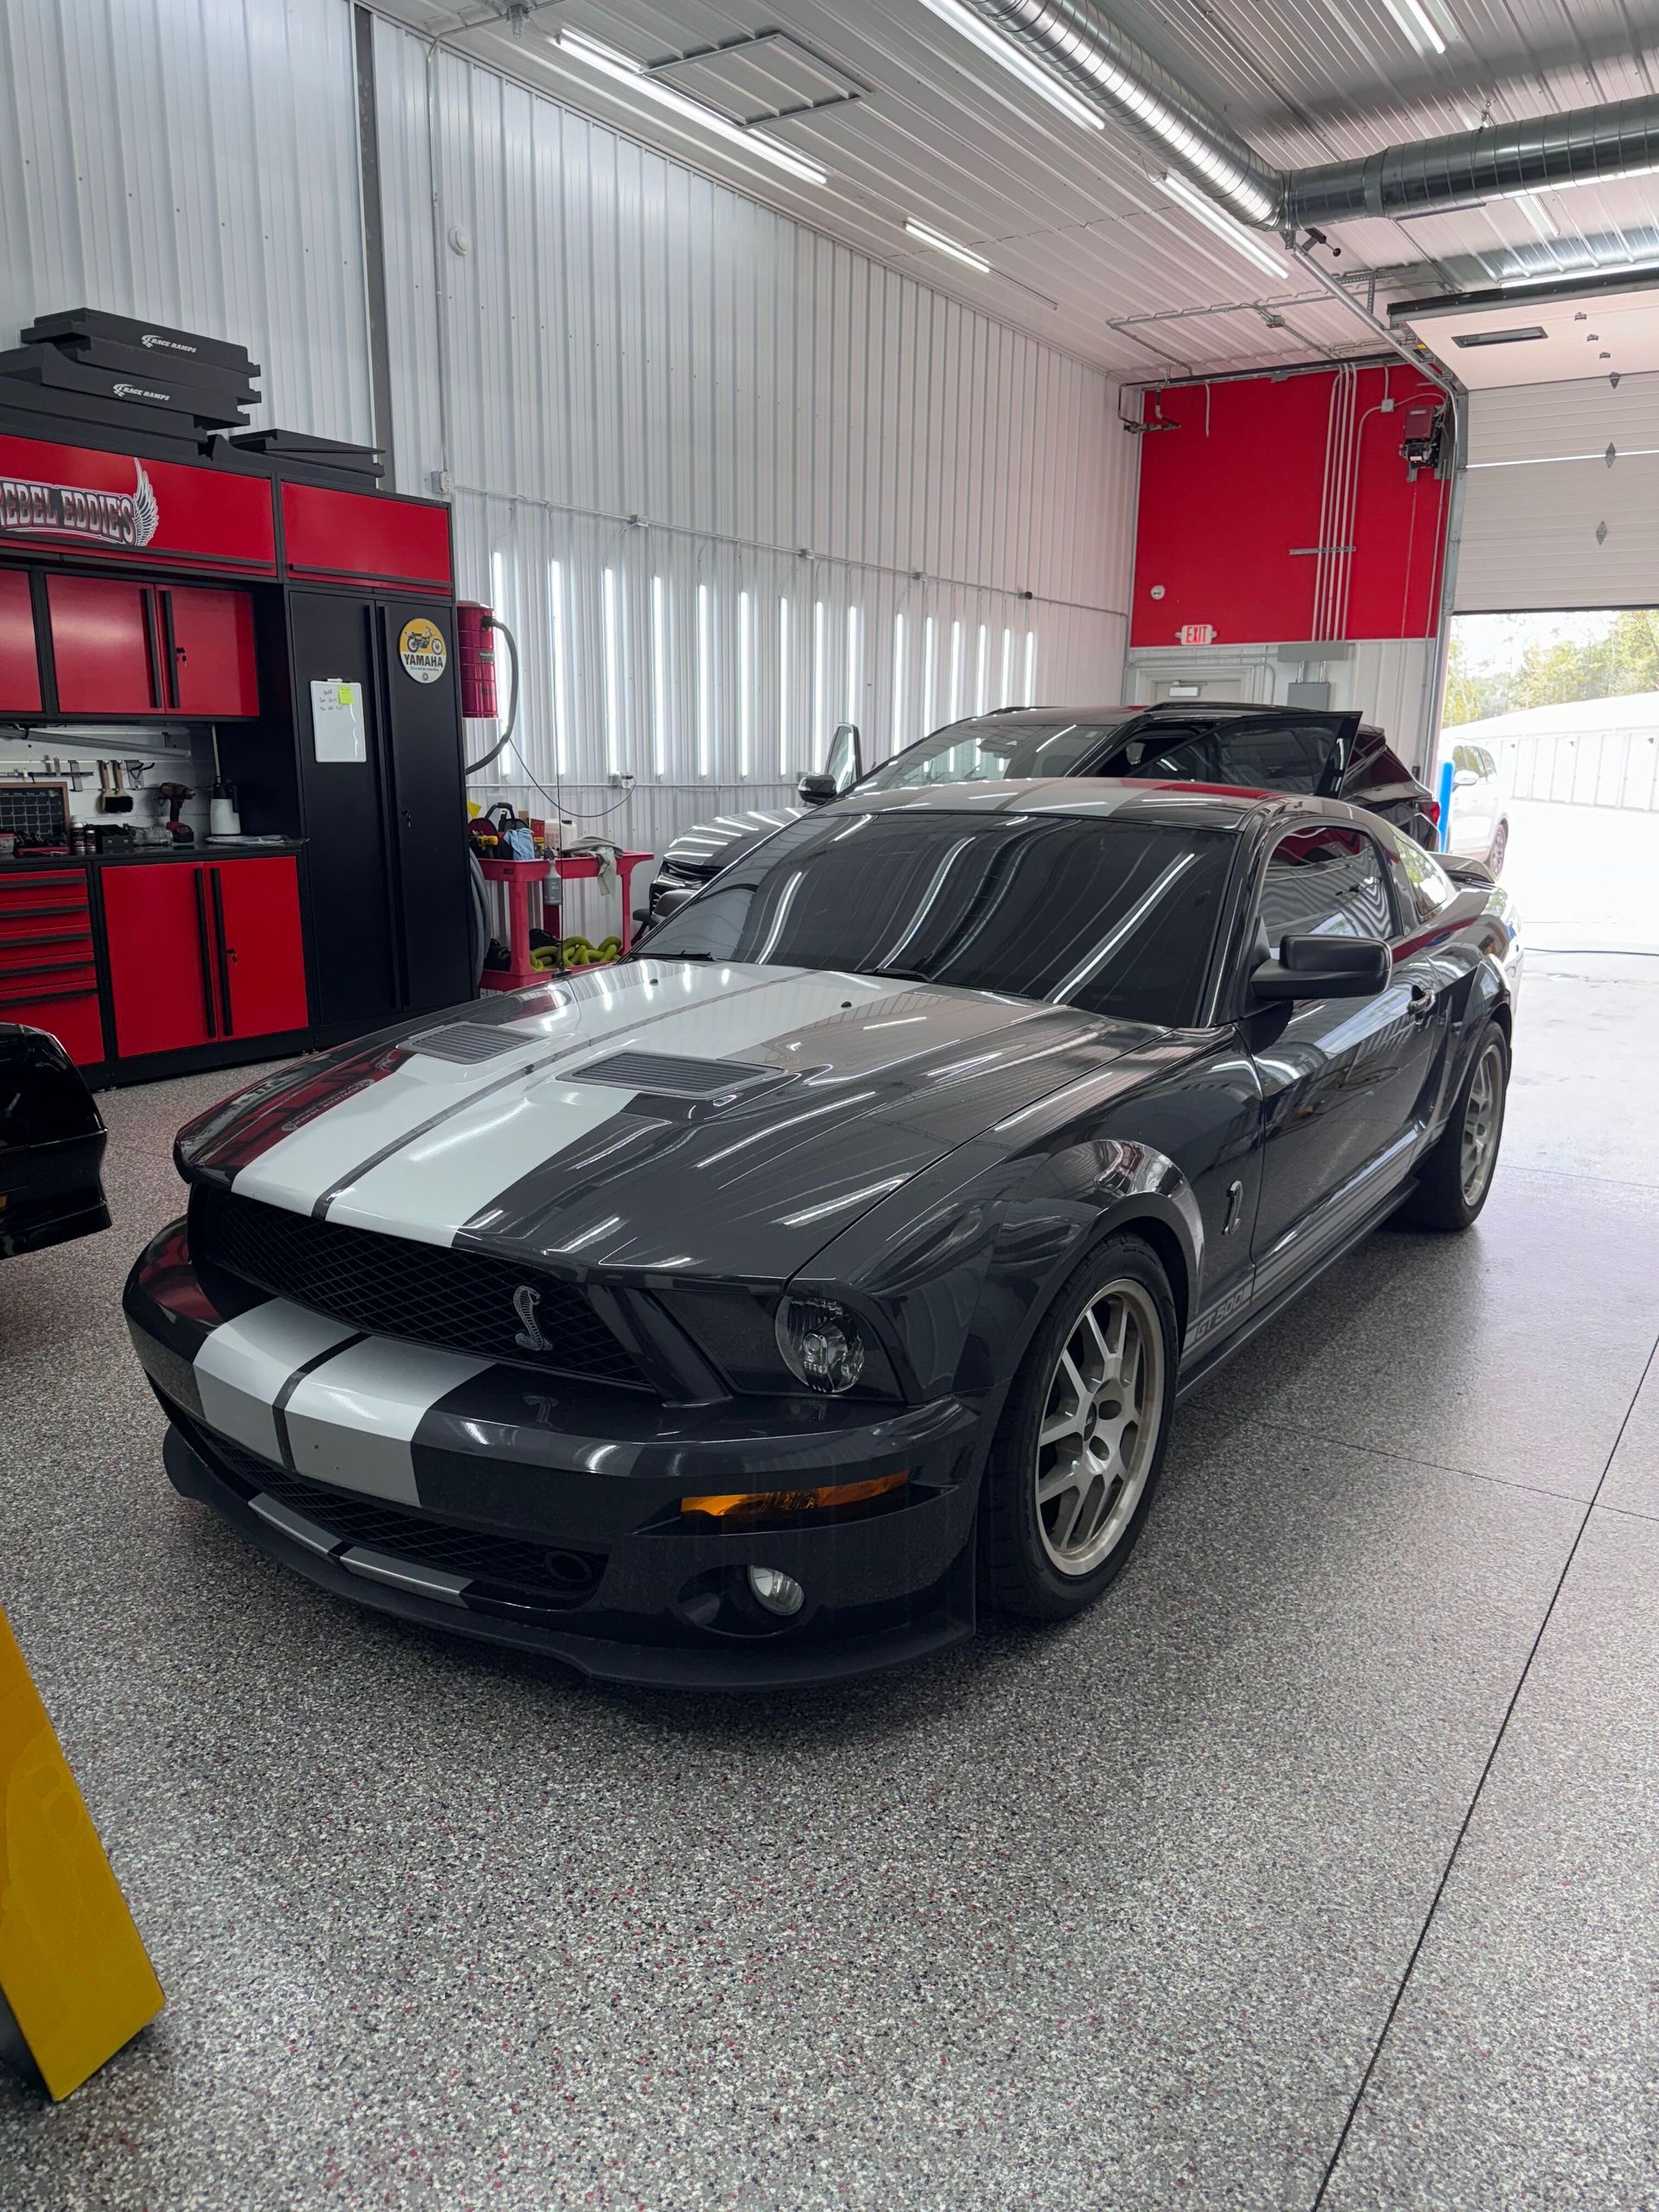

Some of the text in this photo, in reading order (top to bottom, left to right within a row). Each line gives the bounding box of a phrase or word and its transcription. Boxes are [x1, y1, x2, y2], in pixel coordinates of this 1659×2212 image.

[150, 338, 197, 353] RACE RAMPS
[123, 387, 170, 401] RACE RAMPS
[60, 490, 135, 544] EDDIE'S
[1185, 626, 1208, 644] EXIT
[404, 653, 443, 668] YAMAHA
